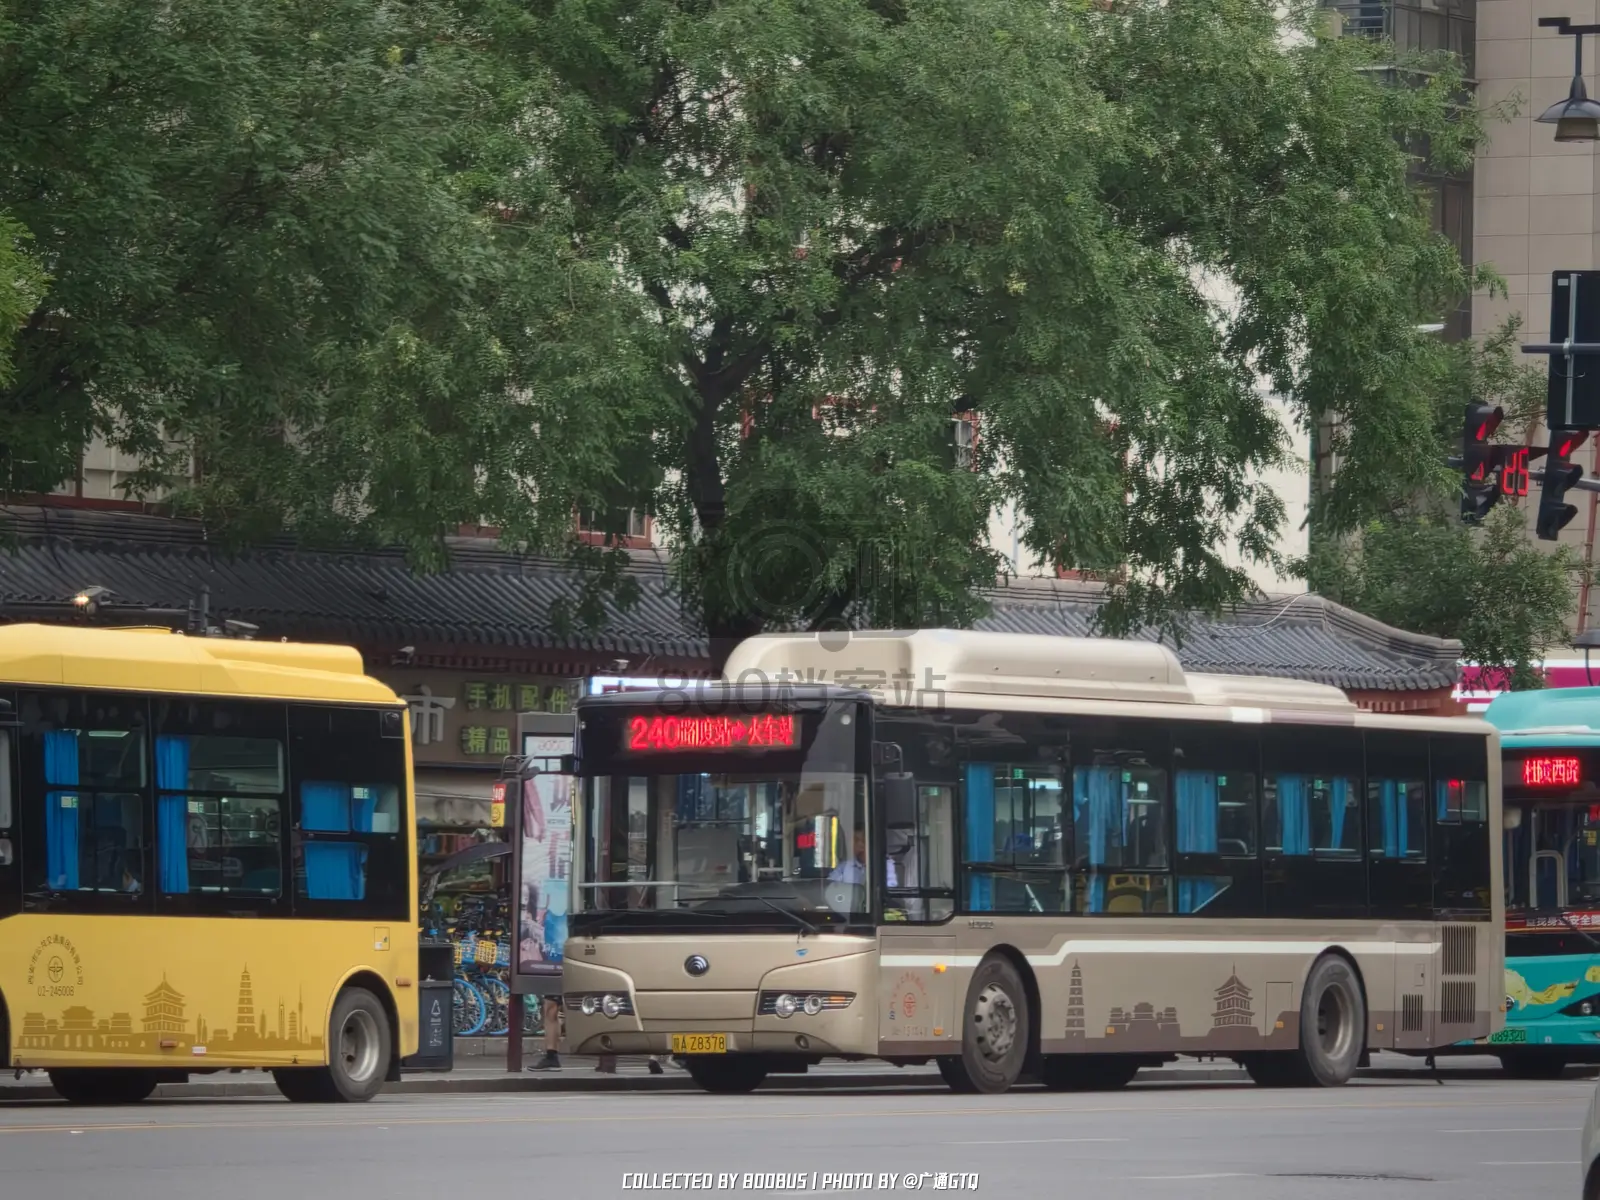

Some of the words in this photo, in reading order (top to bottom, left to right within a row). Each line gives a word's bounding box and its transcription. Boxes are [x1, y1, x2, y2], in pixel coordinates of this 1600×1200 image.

[467, 682, 569, 713] 手机配件
[401, 684, 457, 745] 市
[466, 726, 511, 754] 精品
[1523, 757, 1579, 785] 杜陵西路
